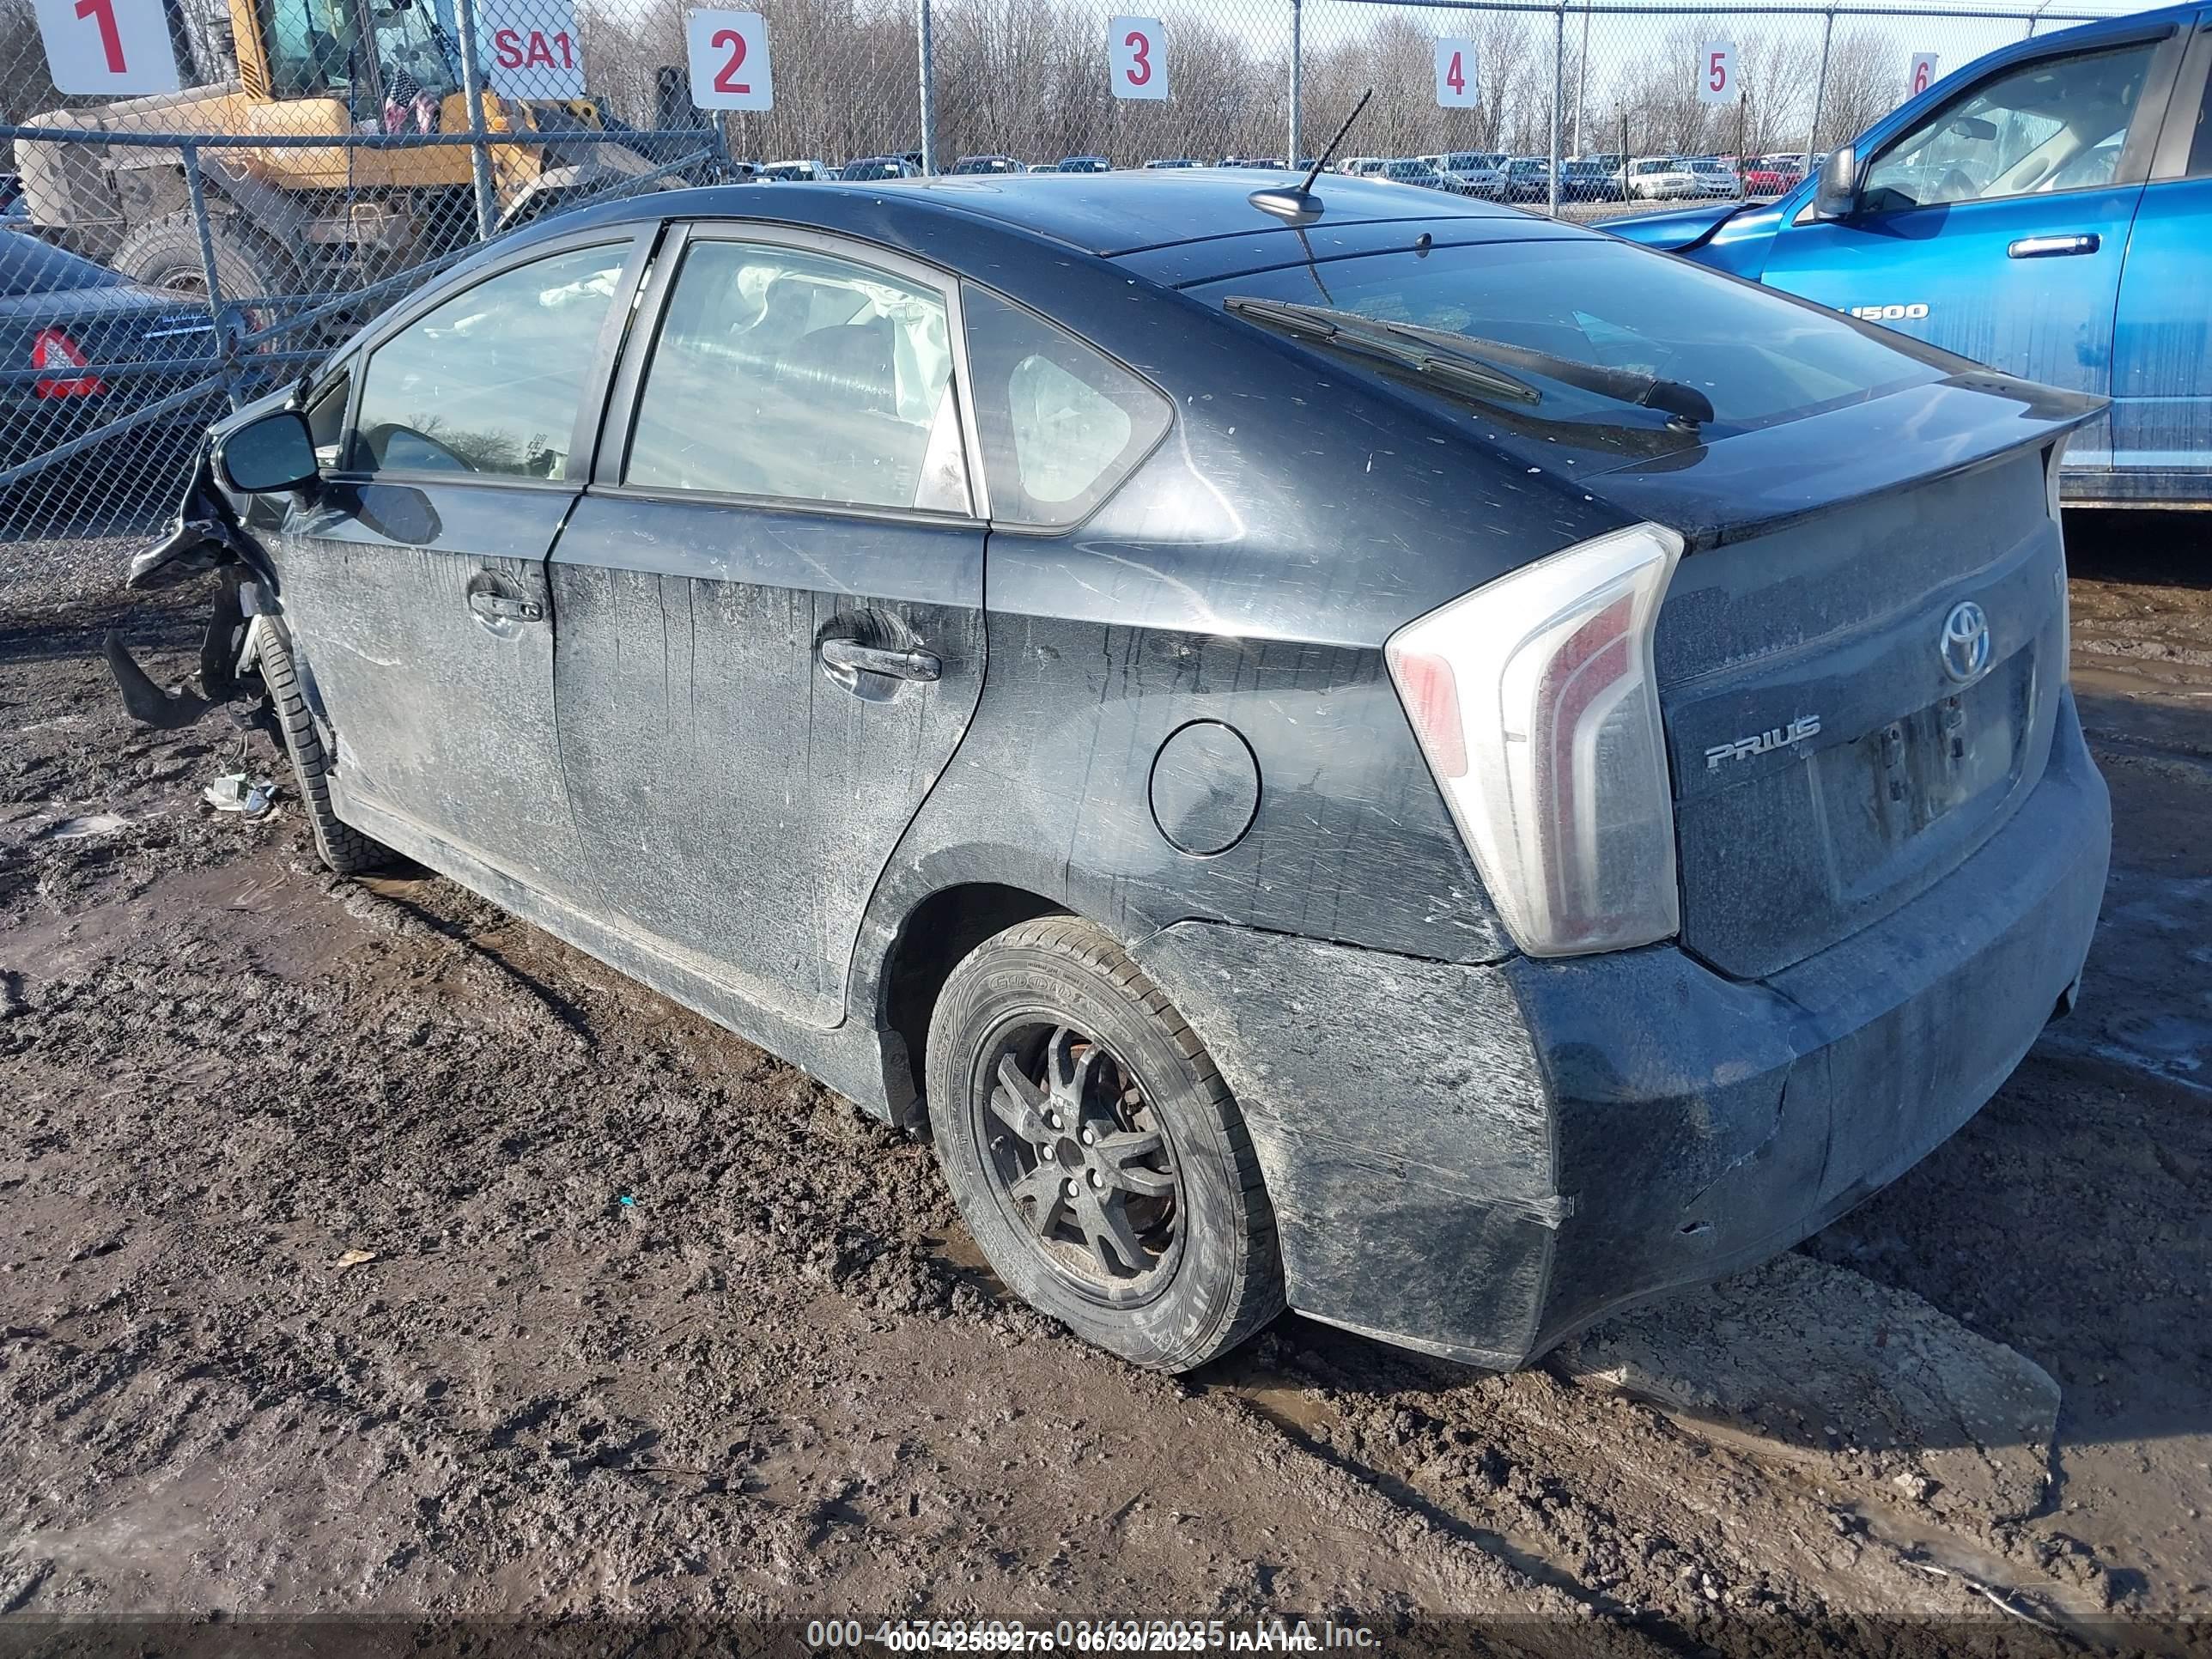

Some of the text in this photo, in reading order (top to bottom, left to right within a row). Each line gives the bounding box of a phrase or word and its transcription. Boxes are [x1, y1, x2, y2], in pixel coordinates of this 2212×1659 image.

[75, 0, 127, 73] 1
[496, 30, 571, 69] SA1
[1126, 32, 1151, 86] 3
[712, 29, 750, 94] 2
[1447, 52, 1465, 95] 4
[1711, 53, 1727, 93] 5
[1915, 62, 1929, 94] 6
[1705, 714, 1821, 769] PRIUS
